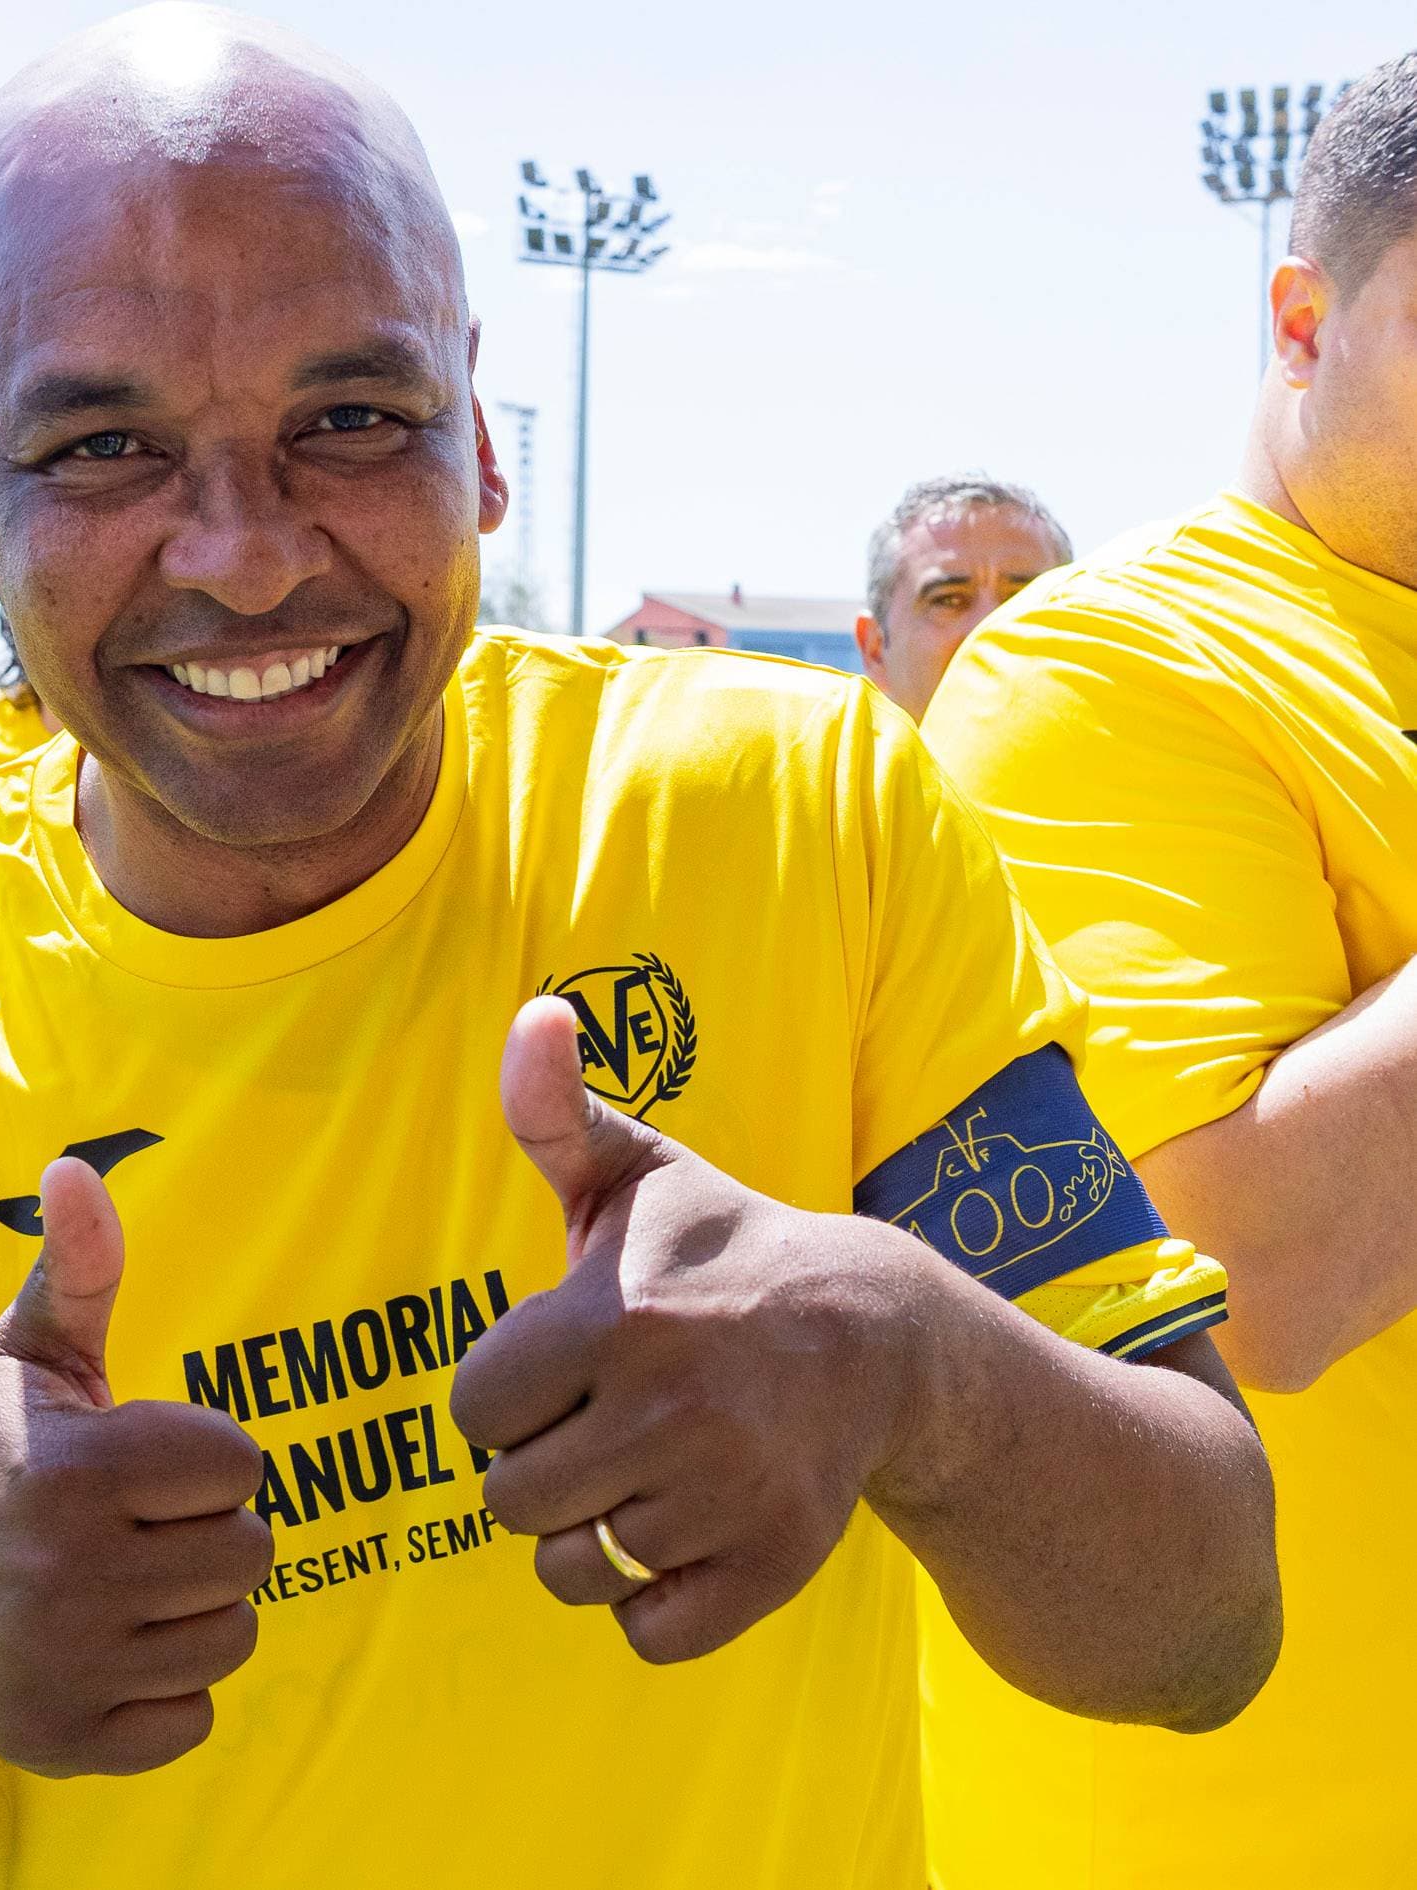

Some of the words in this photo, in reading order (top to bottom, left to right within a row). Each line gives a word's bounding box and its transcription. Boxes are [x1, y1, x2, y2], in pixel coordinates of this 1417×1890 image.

[254, 1403, 456, 1530] ANUEL
[252, 1531, 401, 1606] RESENT,
[406, 1507, 513, 1564] SEMP
